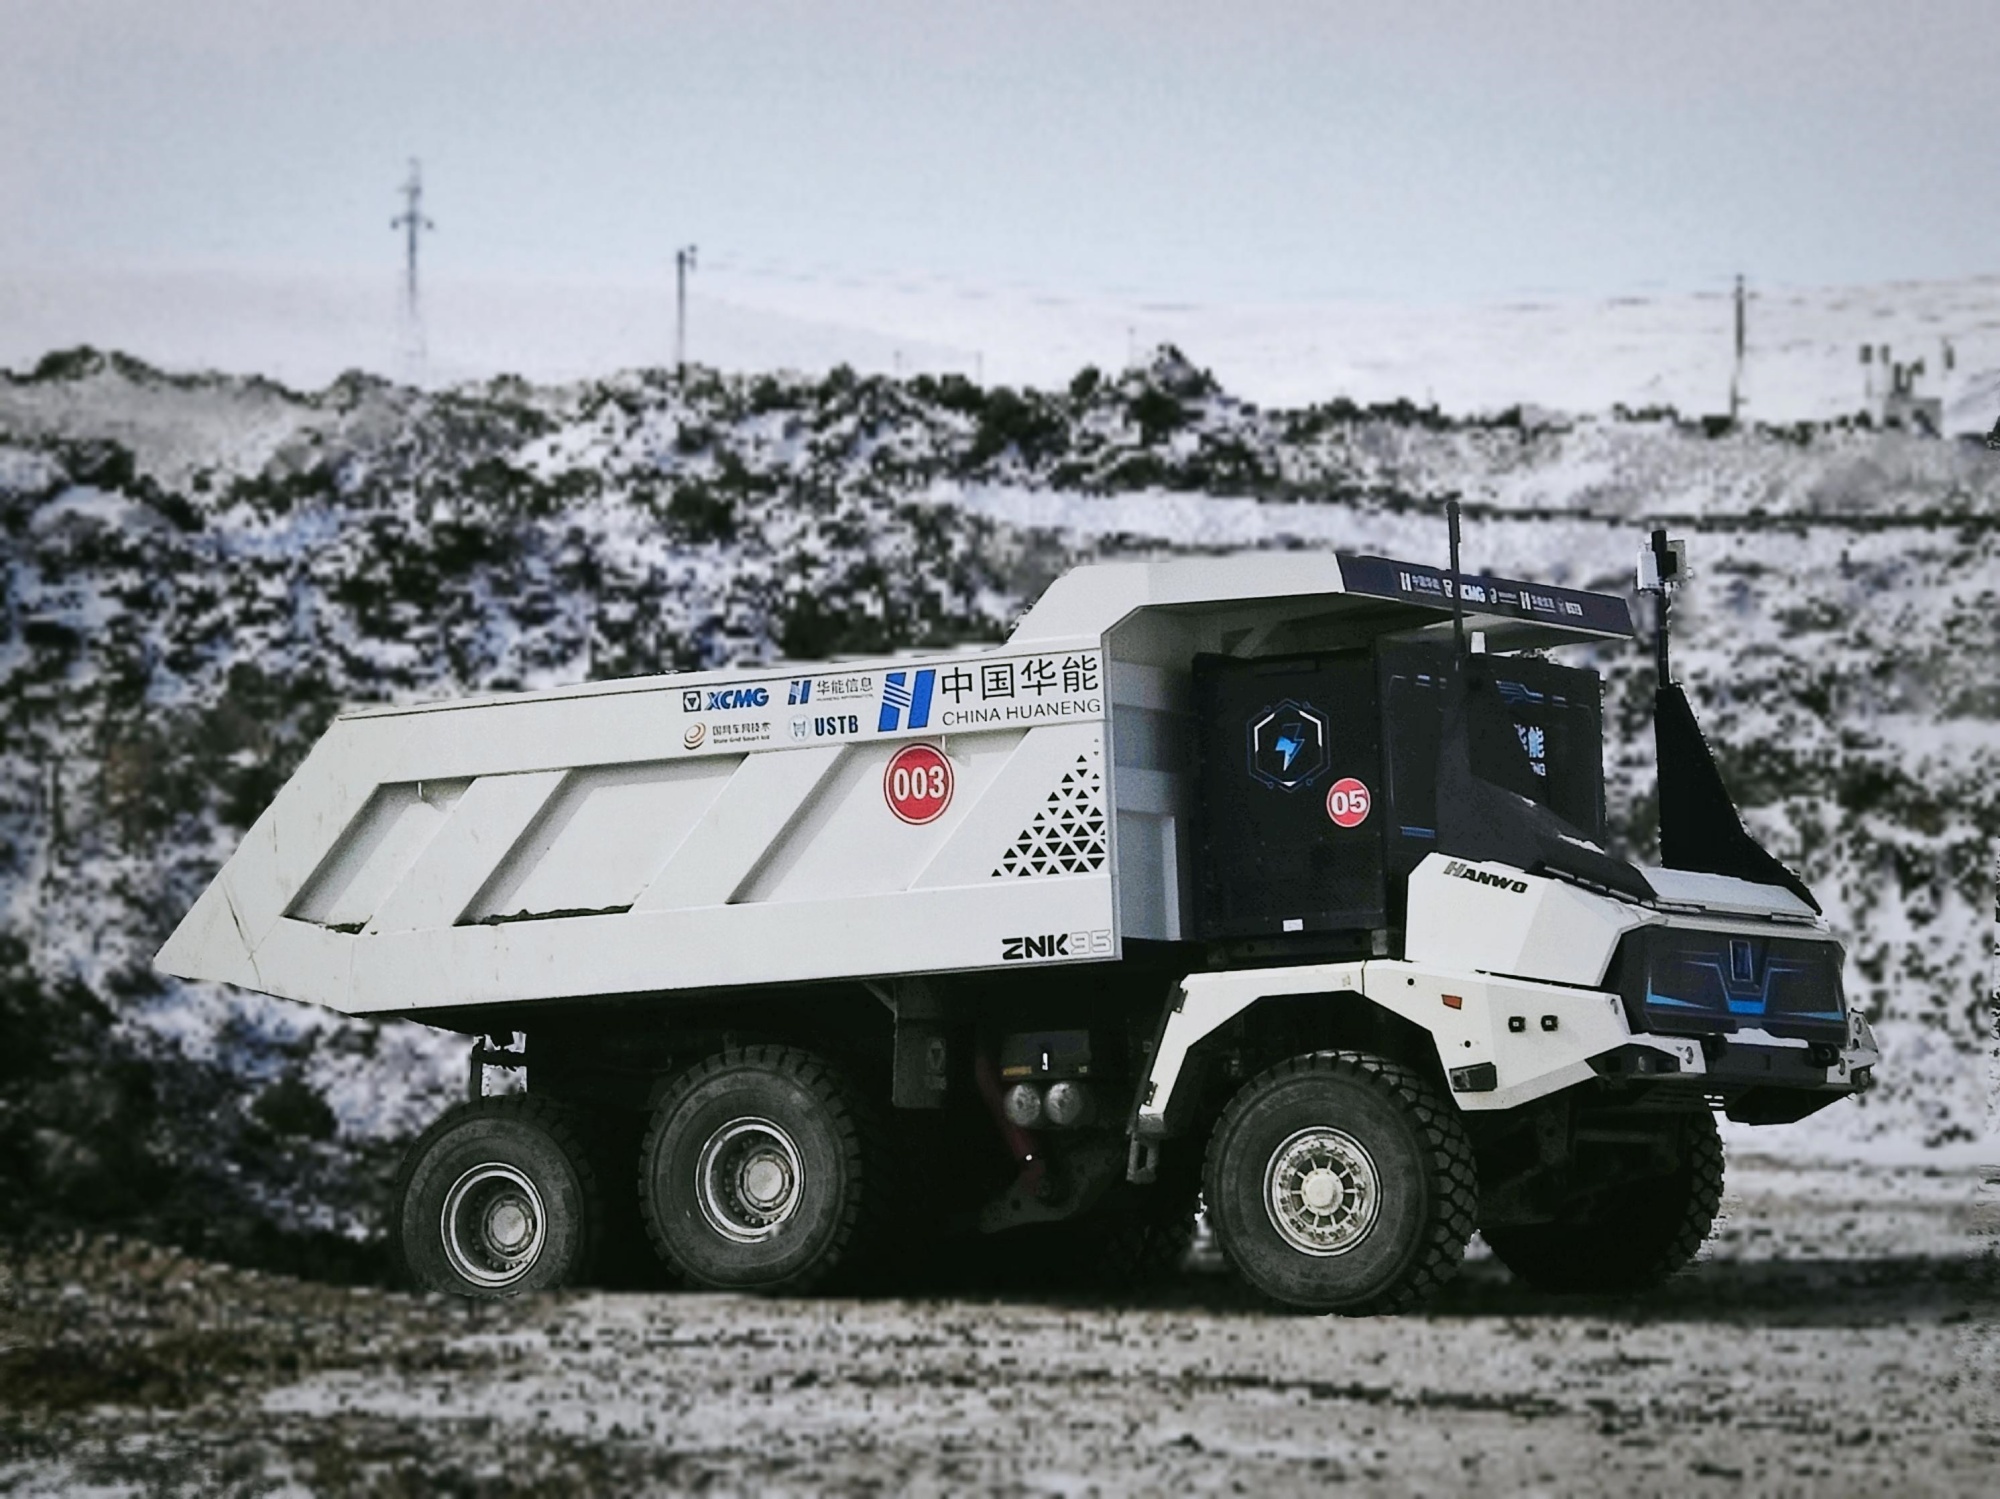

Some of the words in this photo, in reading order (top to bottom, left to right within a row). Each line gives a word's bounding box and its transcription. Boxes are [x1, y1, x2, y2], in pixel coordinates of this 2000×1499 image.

[816, 677, 873, 695] 华能信息
[941, 654, 1099, 704] 中国华能
[704, 687, 769, 711] XCMG
[942, 707, 1001, 726] CHINA
[1006, 698, 1101, 720] HUANENG
[814, 715, 858, 736] USTB
[893, 765, 945, 801] 003
[1331, 789, 1367, 816] 05
[1443, 861, 1528, 894] HANWO
